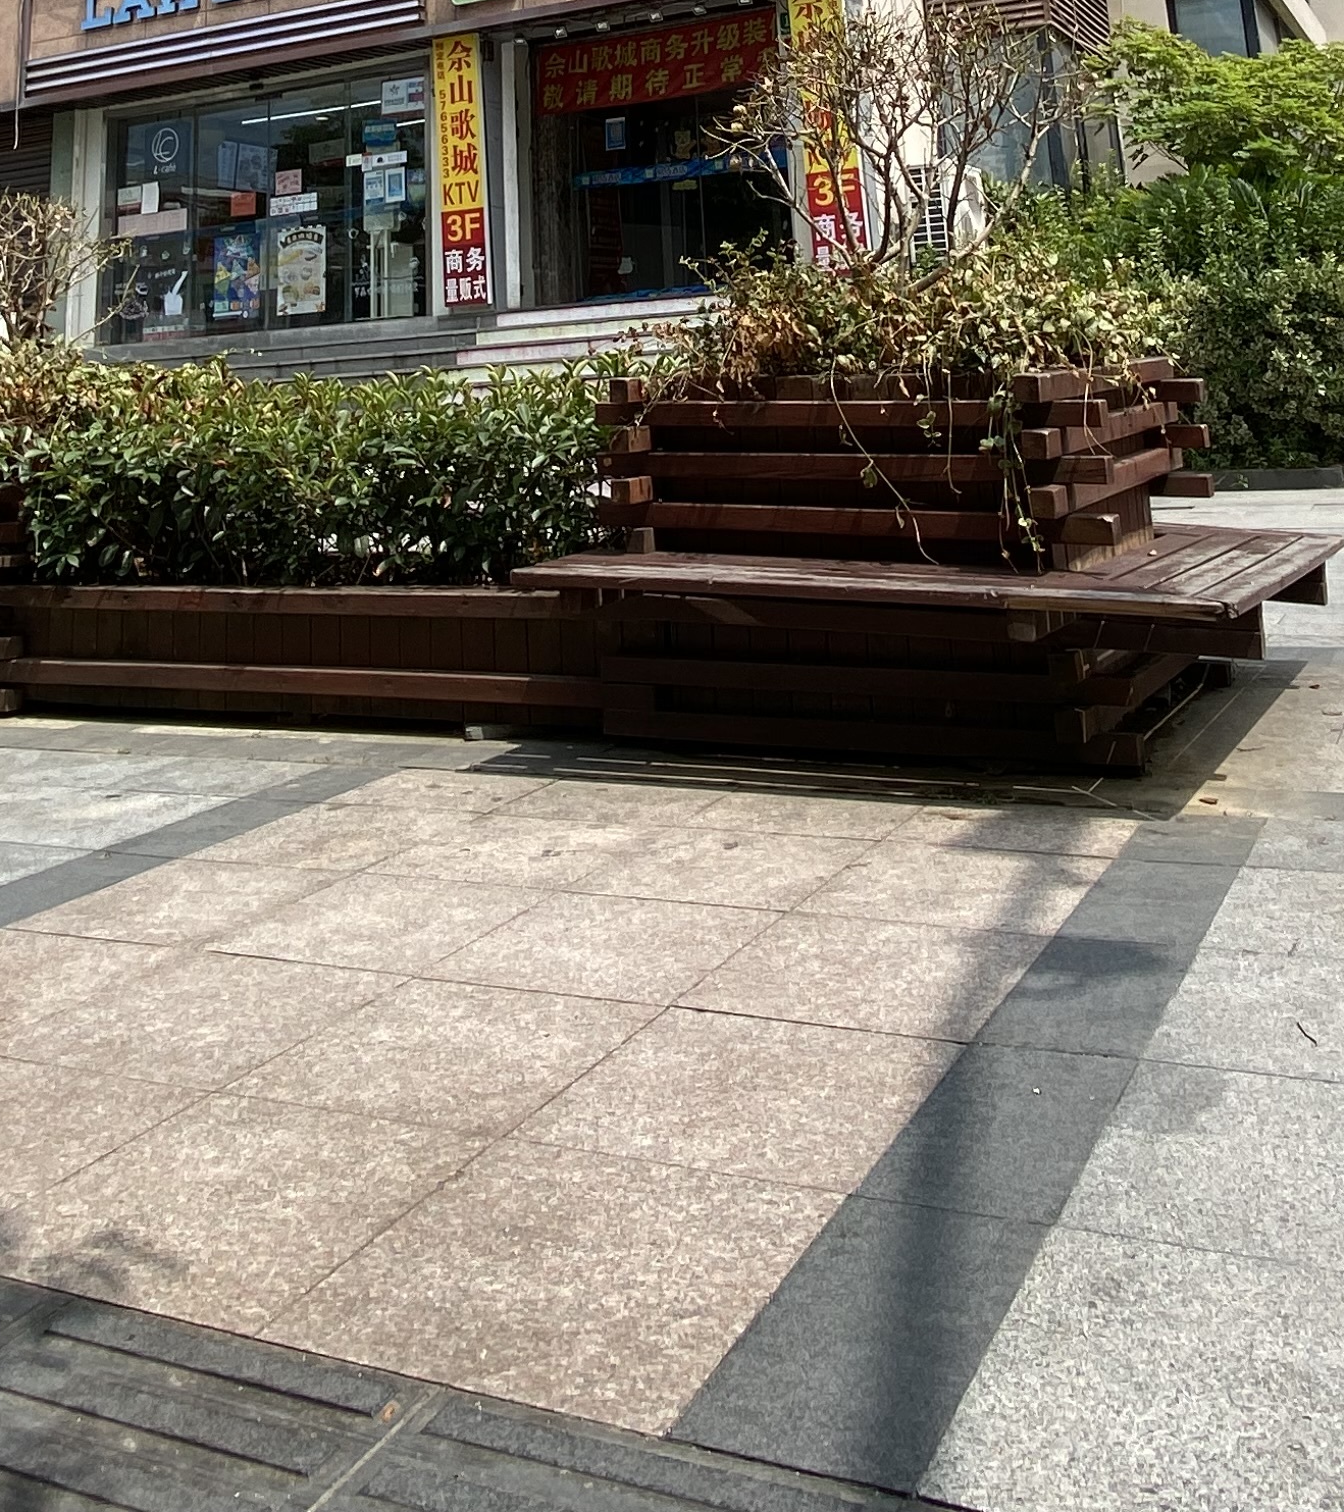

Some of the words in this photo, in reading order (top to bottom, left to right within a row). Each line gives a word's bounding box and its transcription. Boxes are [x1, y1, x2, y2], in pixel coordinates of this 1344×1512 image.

[447, 40, 479, 176] 佘山歌城
[439, 89, 450, 179] 57656333
[443, 180, 480, 206] KTV
[446, 212, 481, 242] 3F
[444, 247, 485, 274] 商务
[445, 275, 487, 303] 量贩式
